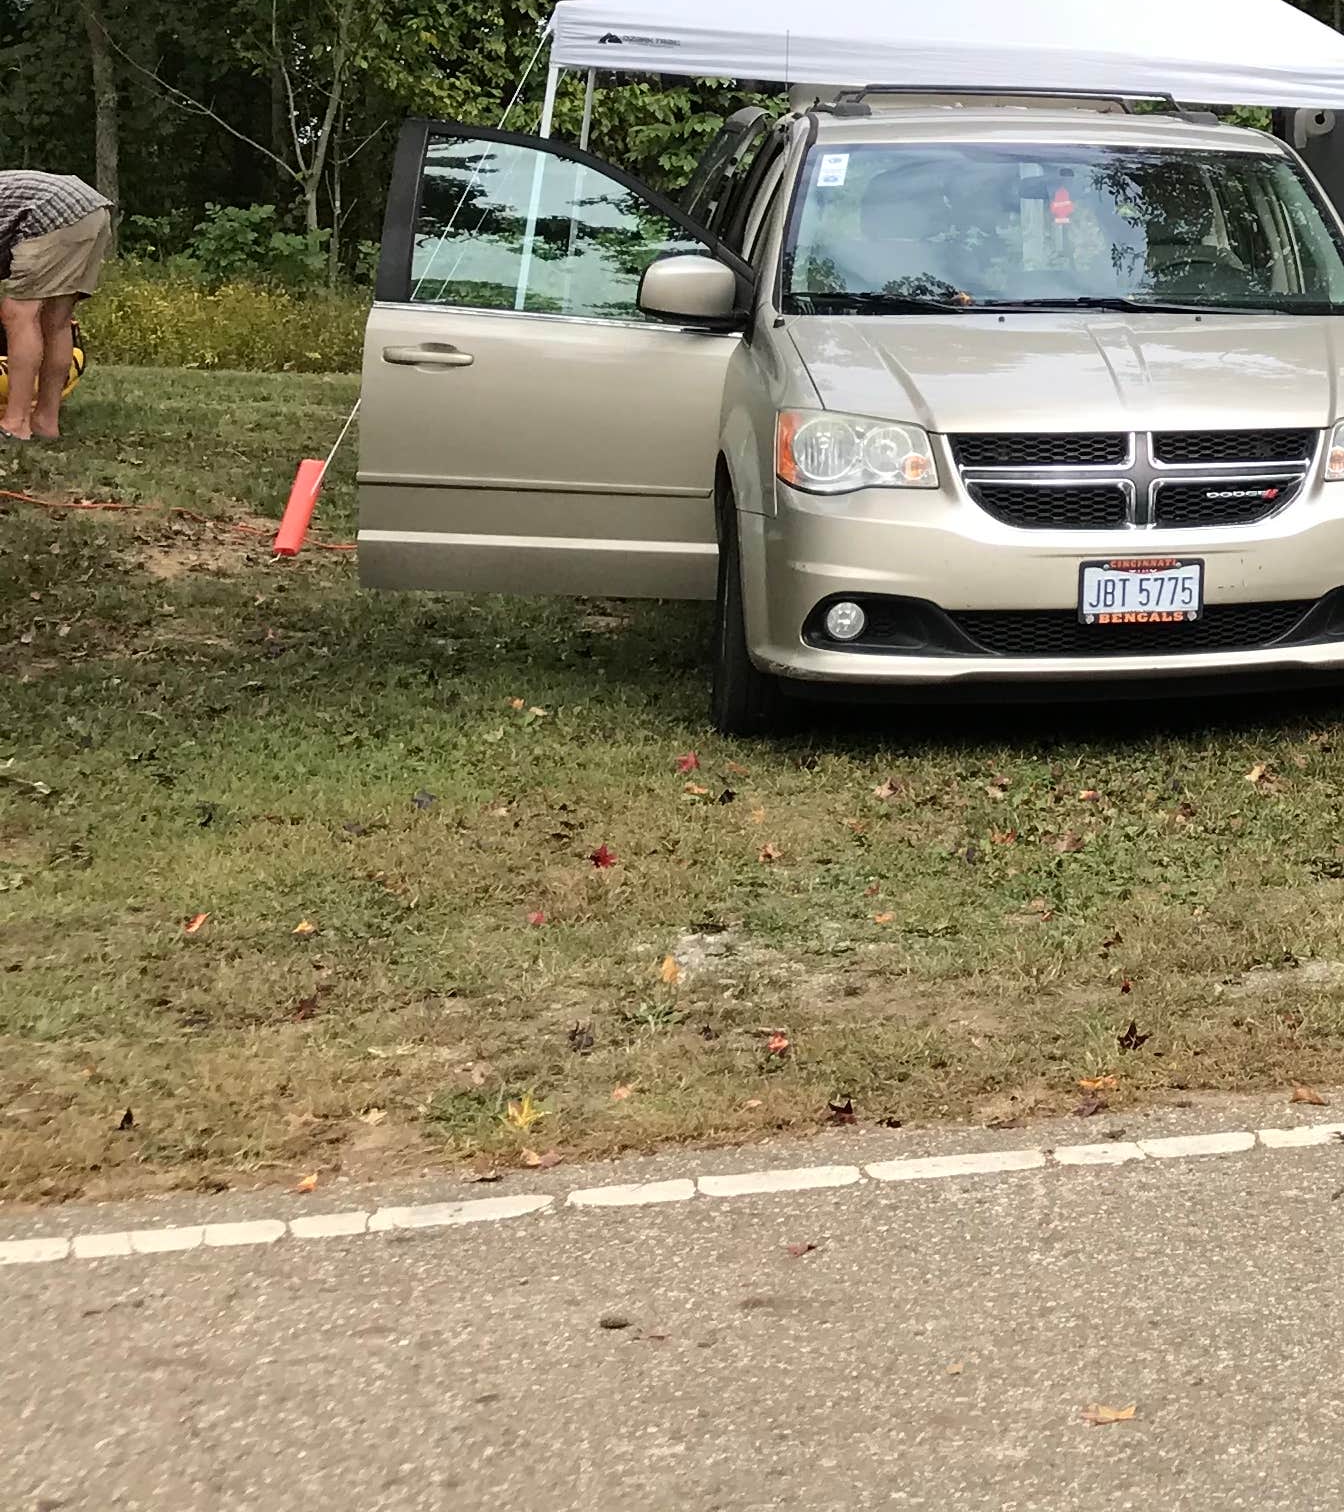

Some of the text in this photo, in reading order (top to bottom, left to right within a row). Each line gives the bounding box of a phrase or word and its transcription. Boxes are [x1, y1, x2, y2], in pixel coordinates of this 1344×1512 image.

[1089, 576, 1194, 608] JBT 5775
[1098, 612, 1184, 624] BENGALS
